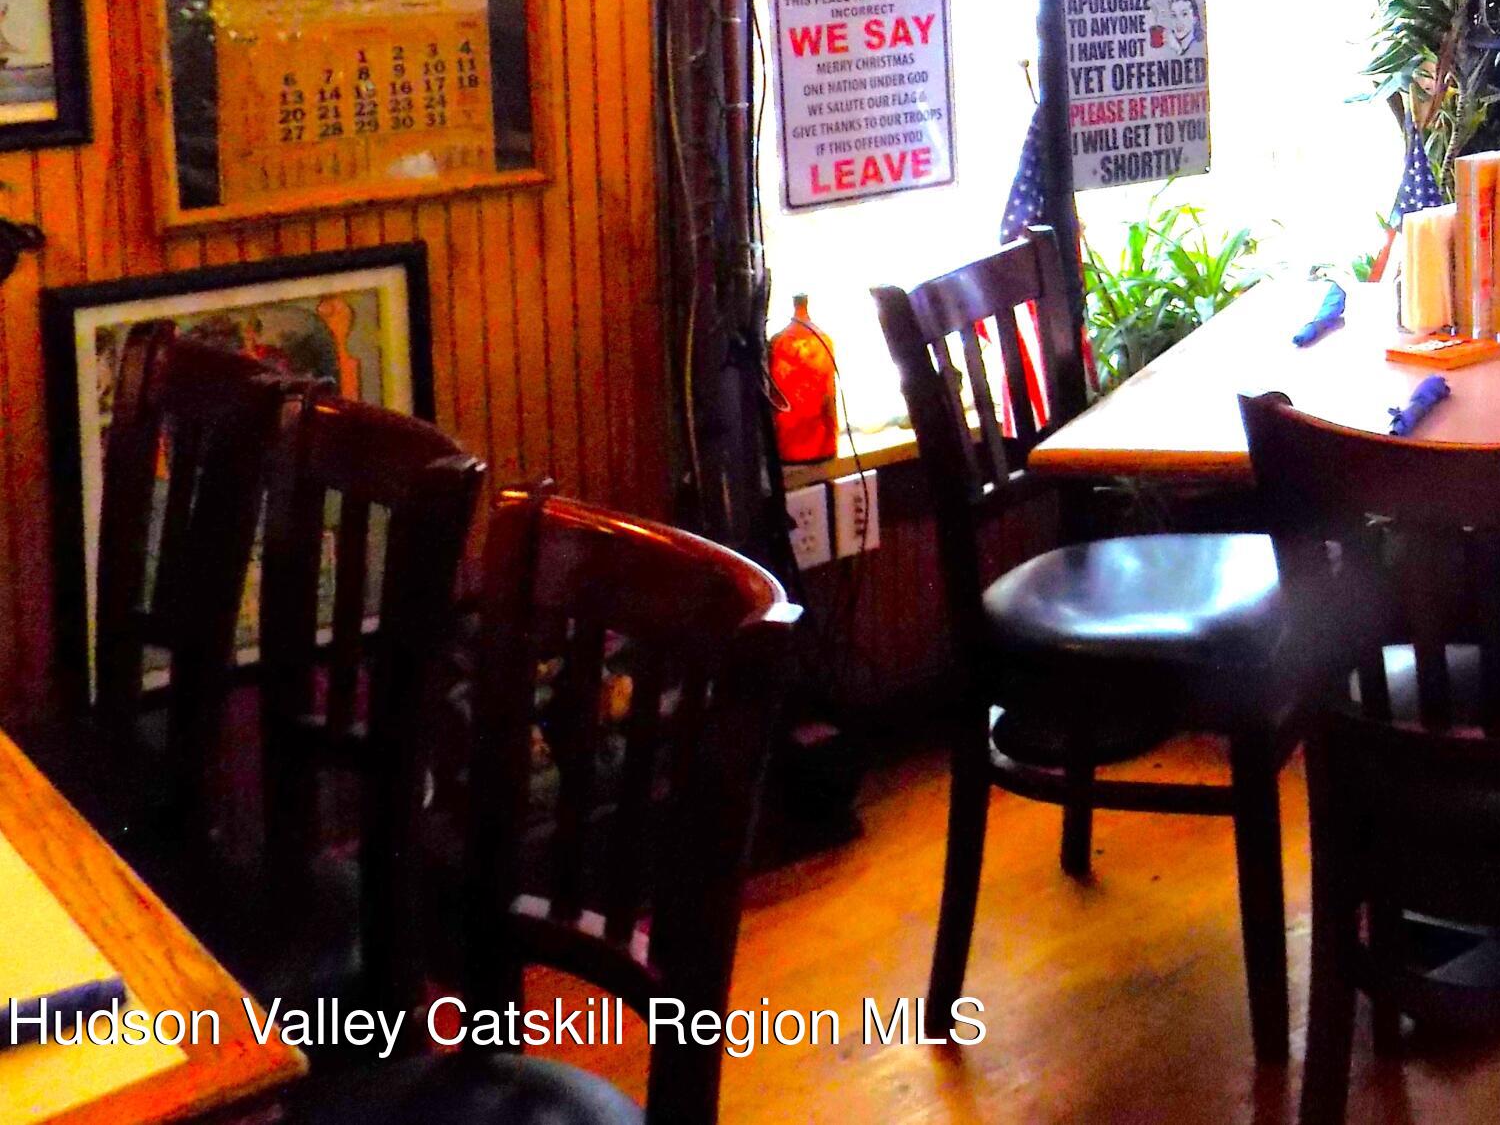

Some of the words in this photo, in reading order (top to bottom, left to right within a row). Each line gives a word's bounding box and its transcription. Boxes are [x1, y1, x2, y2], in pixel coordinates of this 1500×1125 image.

[831, 3, 896, 18] INCORRECT
[1068, 18, 1087, 38] TO
[1090, 14, 1146, 37] ANYONE
[357, 49, 367, 64] 1
[393, 45, 404, 61] 2
[428, 43, 439, 57] 3
[459, 40, 471, 55] 4
[788, 24, 850, 58] WE
[863, 14, 936, 51] SAY
[1069, 43, 1075, 63] I
[1078, 39, 1115, 62] HAVE
[1118, 38, 1146, 59] NOT
[322, 68, 334, 84] 7
[423, 59, 446, 75] 10
[456, 57, 476, 73] 11
[817, 58, 853, 74] MERRY
[856, 52, 915, 71] CHRISTMAS
[1071, 65, 1106, 95] YET
[1112, 57, 1207, 92] OFFENDED
[279, 89, 304, 106] 13
[317, 87, 341, 103] 14
[389, 81, 413, 96] 16
[423, 76, 446, 92] 17
[457, 73, 480, 89] 18
[803, 81, 825, 97] ONE
[828, 77, 868, 94] NATION
[870, 73, 905, 90] UNDER
[907, 71, 929, 85] GOD
[279, 106, 306, 124] 20
[317, 104, 340, 120] 21
[354, 99, 379, 117] 22
[389, 98, 414, 114] 23
[423, 92, 446, 109] 24
[807, 102, 825, 117] WE
[827, 98, 866, 115] SALUTE
[867, 95, 889, 110] OUR
[892, 92, 917, 107] FLAG
[1070, 99, 1125, 126] PLEASE
[1128, 97, 1147, 121] BE
[1151, 90, 1207, 118] PATIENT
[280, 125, 305, 142] 27
[319, 121, 345, 138] 28
[354, 117, 379, 134] 29
[389, 115, 414, 131] 30
[424, 110, 447, 127] 31
[793, 124, 818, 140] GIVE
[820, 120, 862, 137] THANKS
[864, 117, 878, 130] TO
[880, 114, 901, 128] OUR
[903, 107, 942, 124] TROOPS
[1081, 128, 1120, 155] WILL
[1122, 123, 1151, 149] GET
[1156, 122, 1176, 145] TO
[1178, 118, 1206, 143] YOU
[816, 142, 826, 156] IF
[828, 139, 852, 155] THIS
[854, 134, 900, 152] OFFENDS
[902, 130, 923, 145] YOU
[809, 146, 932, 197] LEAVE
[1100, 146, 1184, 185] SHORTLY
